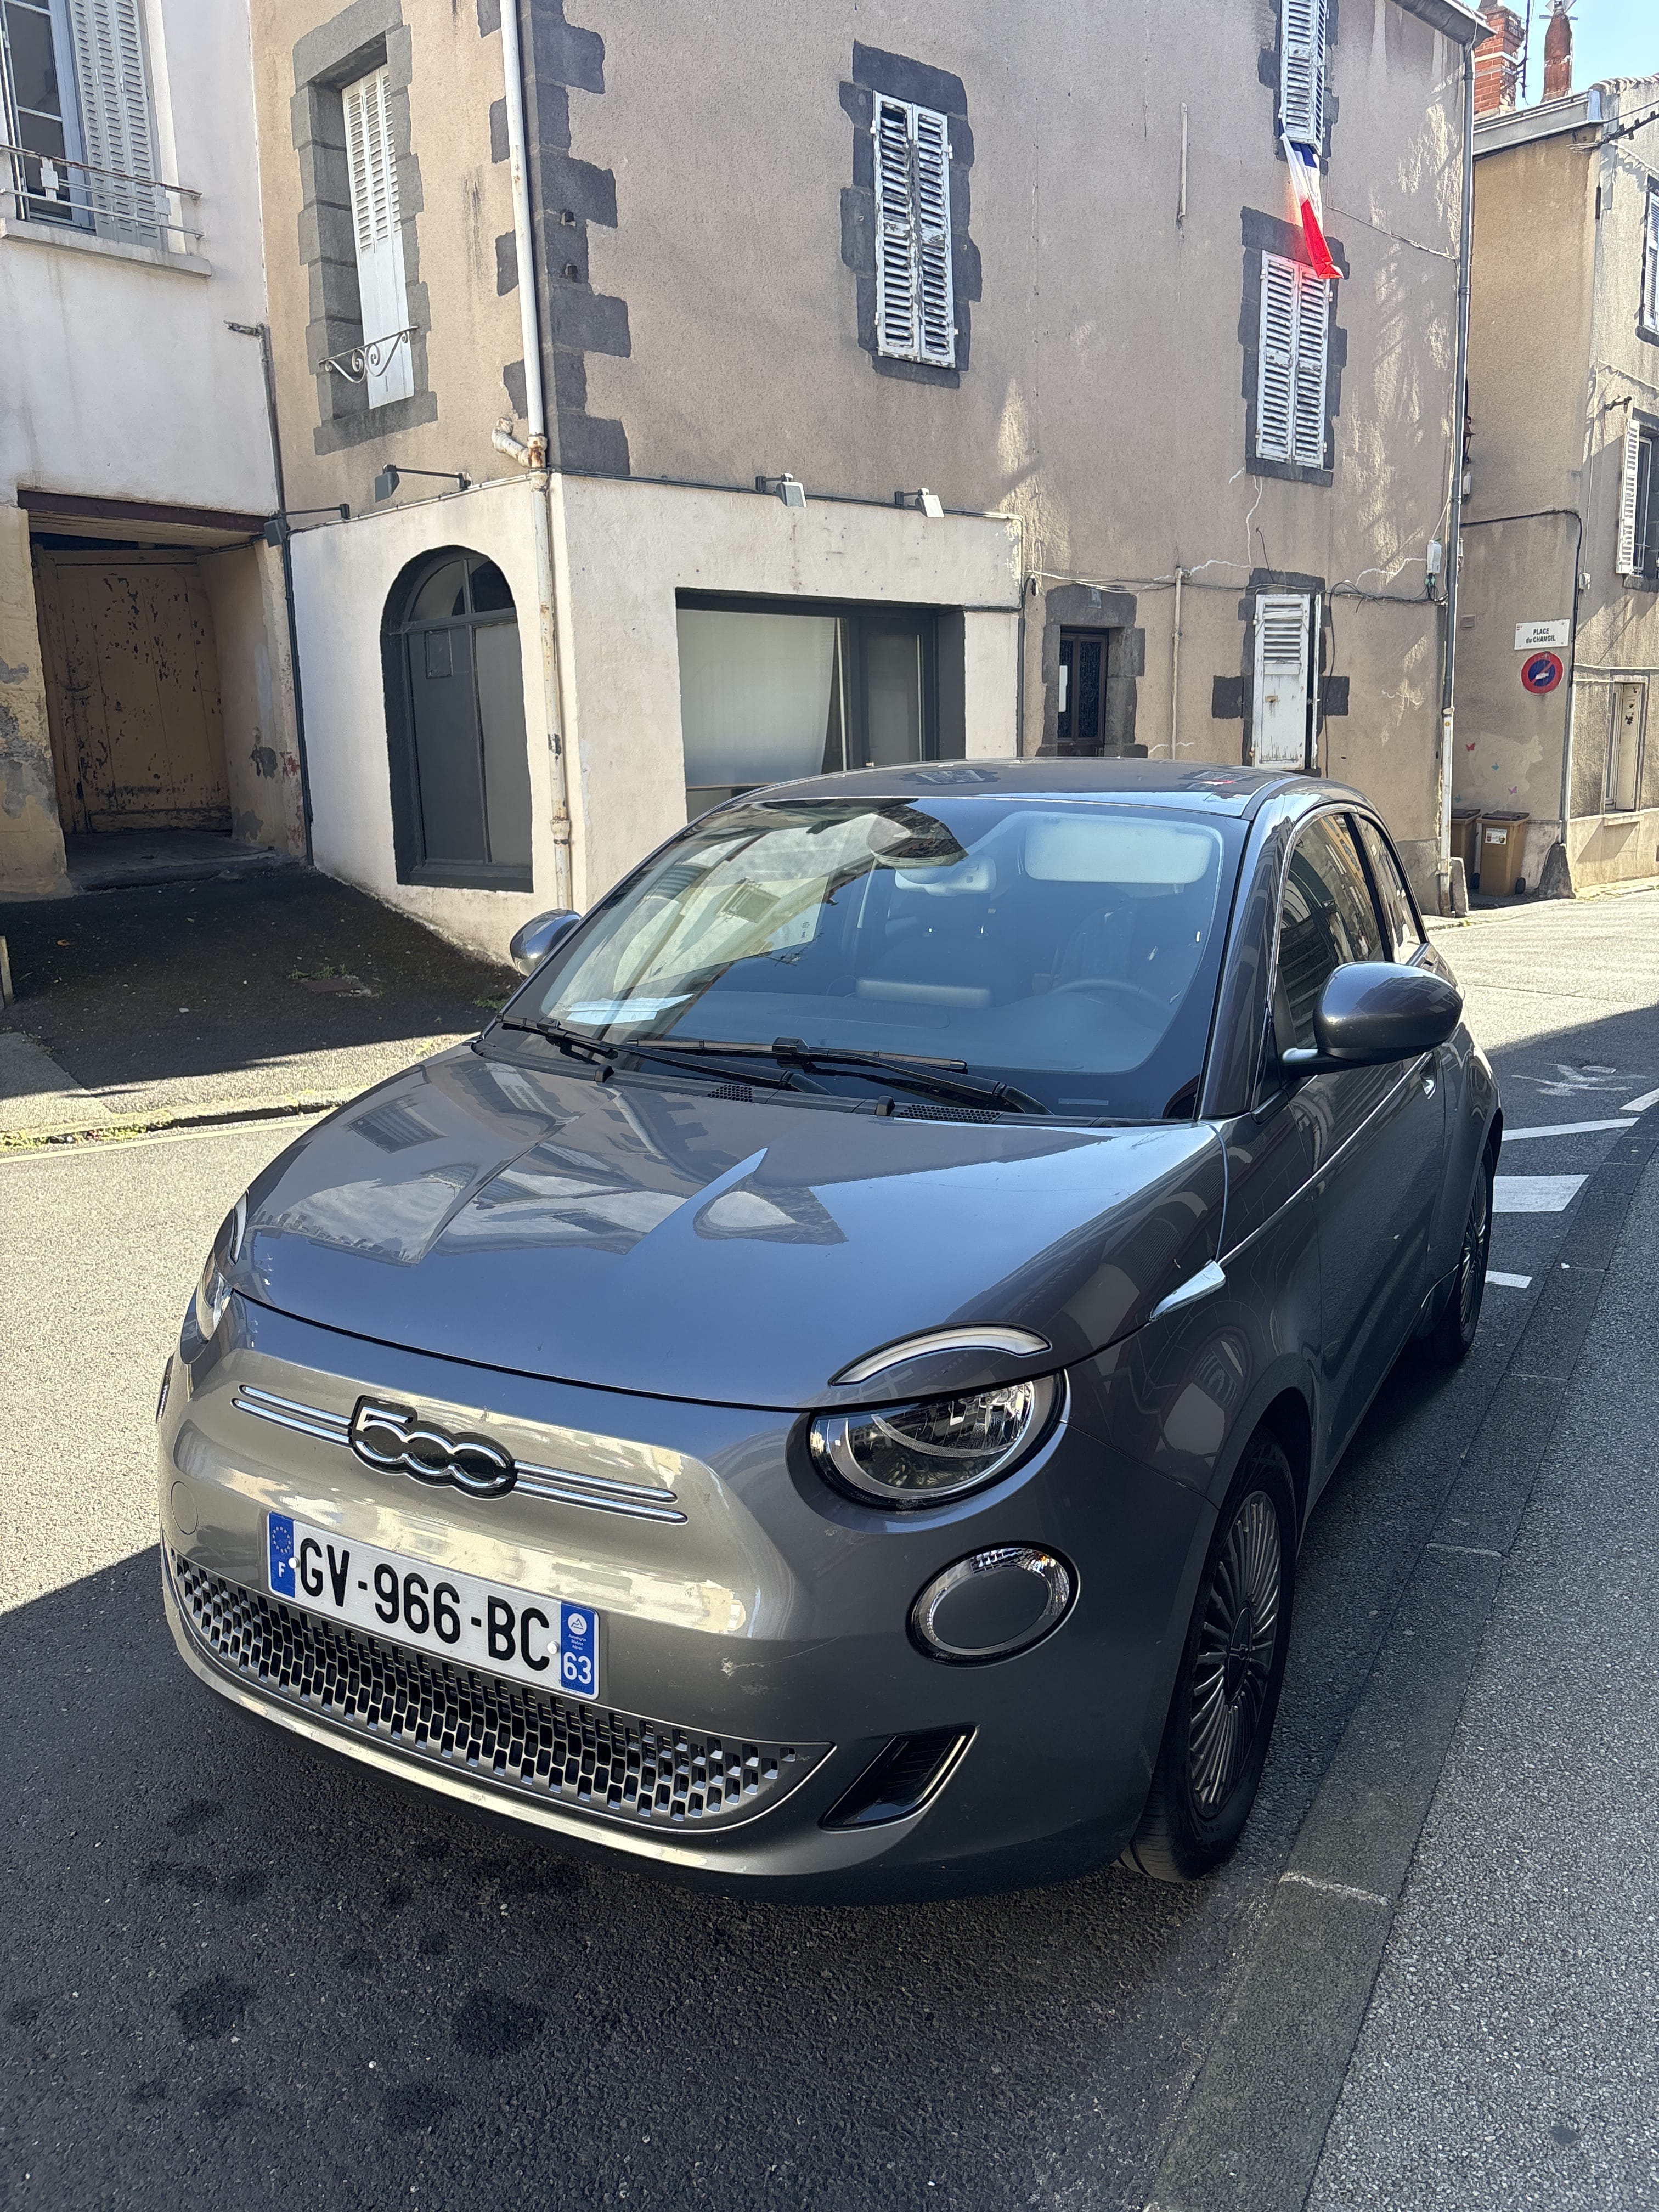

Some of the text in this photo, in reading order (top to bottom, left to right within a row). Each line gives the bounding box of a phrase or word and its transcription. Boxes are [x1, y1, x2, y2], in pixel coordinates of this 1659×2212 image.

[352, 1400, 515, 1493] 500
[278, 1561, 286, 1577] F
[300, 1538, 550, 1671] GV-966-BC
[563, 1651, 592, 1684] 63
